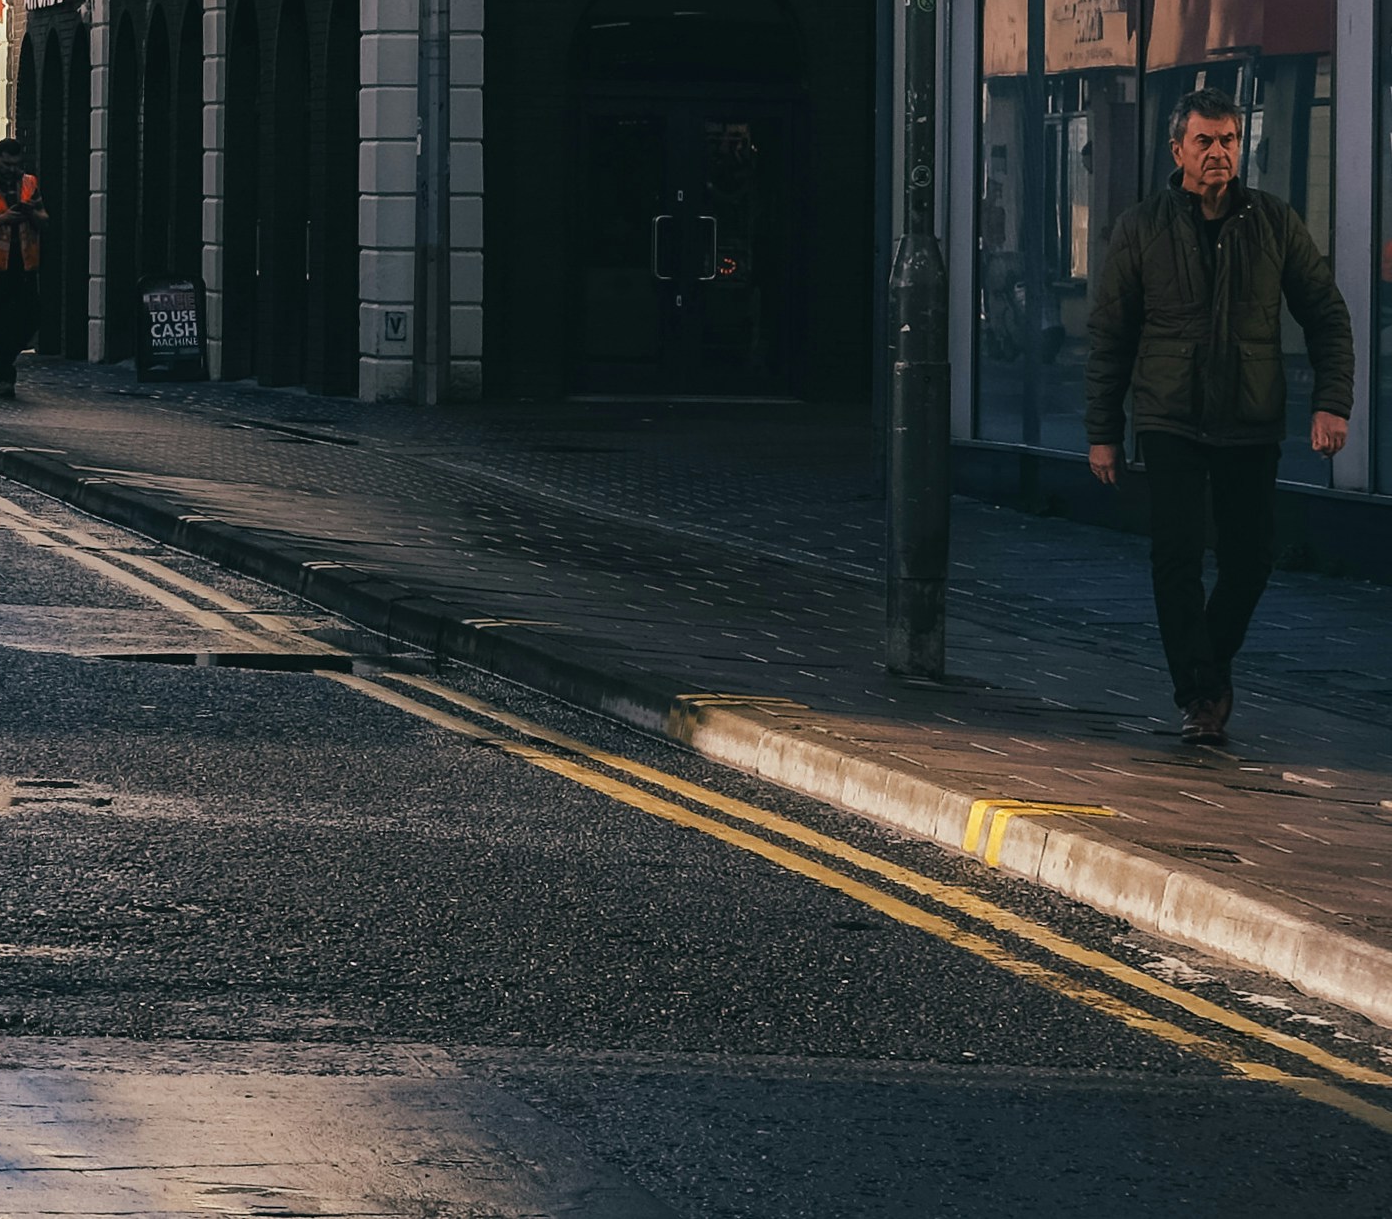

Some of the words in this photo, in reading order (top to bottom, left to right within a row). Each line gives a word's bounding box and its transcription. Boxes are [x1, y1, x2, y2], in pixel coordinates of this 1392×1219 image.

[149, 311, 168, 323] TO
[171, 310, 197, 322] USE
[150, 322, 198, 338] CASH
[389, 316, 402, 334] V
[152, 337, 199, 347] MACHINE
